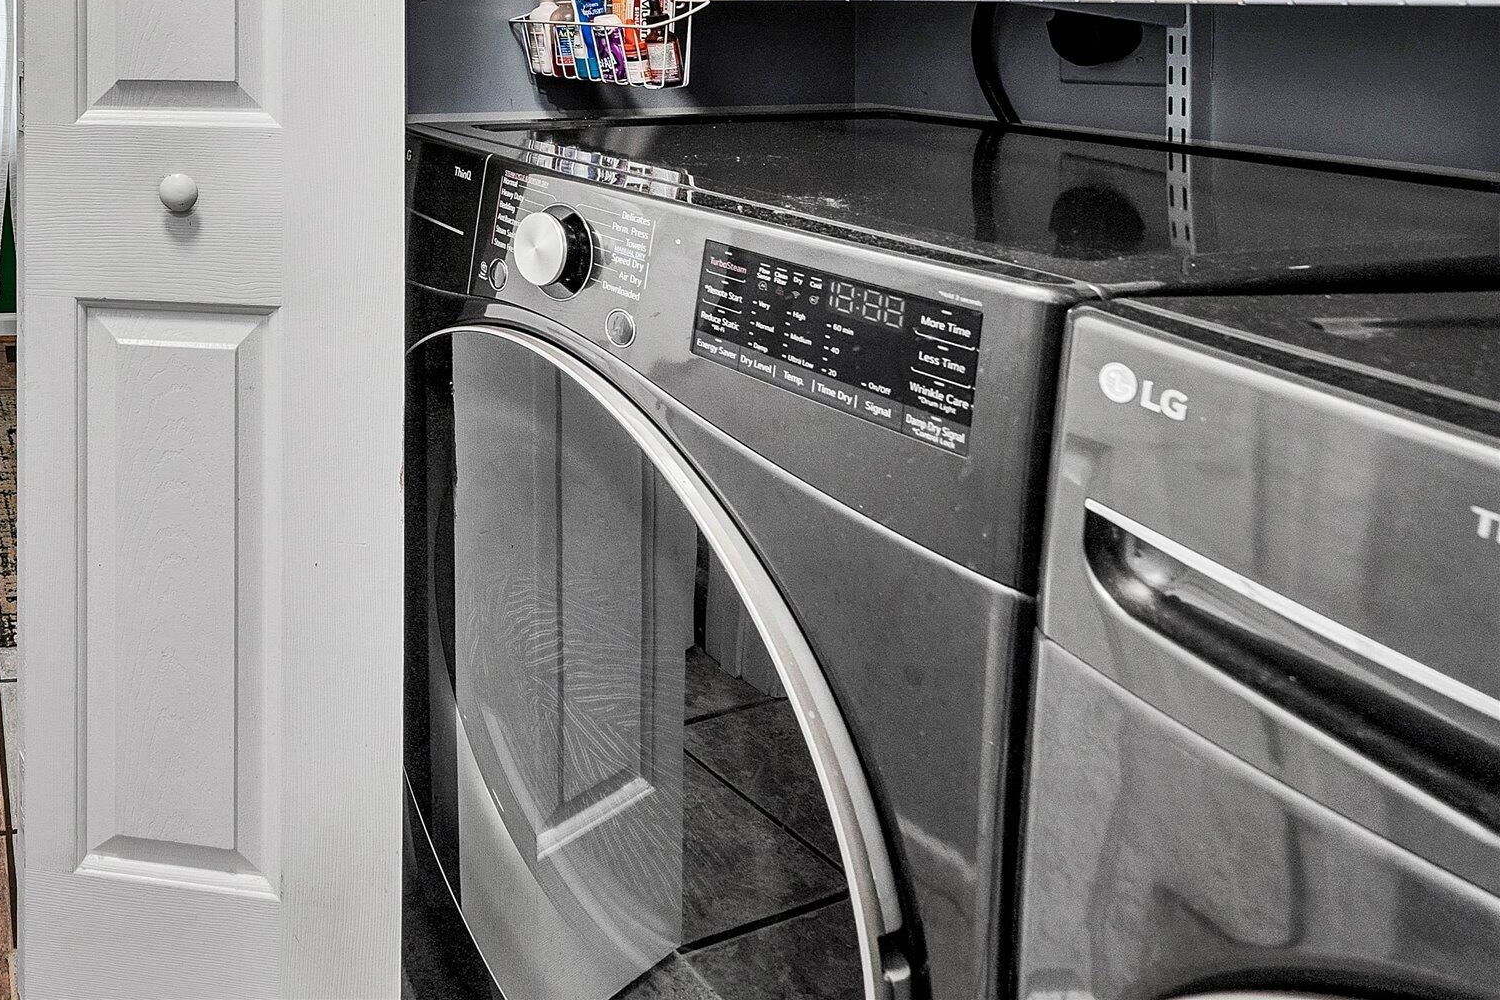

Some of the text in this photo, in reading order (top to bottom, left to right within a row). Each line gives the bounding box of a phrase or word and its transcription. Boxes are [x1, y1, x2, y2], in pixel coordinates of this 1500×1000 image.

[454, 166, 472, 181] ThinQ
[621, 211, 651, 226] Delicates
[630, 227, 649, 240] Press
[625, 238, 647, 253] Towels
[611, 253, 645, 272] Speed Dry
[710, 256, 747, 275] TurboSteam
[618, 271, 643, 287] Air Dry
[793, 276, 803, 286] Dry
[809, 281, 823, 290] Cool
[602, 280, 641, 301] Downloaded
[728, 291, 743, 304] Start
[758, 300, 771, 311] Very
[700, 310, 740, 331] Reduce Static
[792, 311, 806, 322] High
[755, 321, 775, 333] Normal
[832, 323, 854, 336] 60 min
[920, 315, 972, 338] More Time
[790, 333, 813, 346] Medium
[696, 338, 738, 360] Energy Saver
[752, 342, 769, 353] Damp
[830, 346, 841, 355] 40
[740, 354, 772, 374] Dry Level
[802, 359, 815, 370] Low
[918, 350, 967, 374] Less Time
[783, 369, 805, 387] Temp.
[827, 368, 838, 378] 20
[817, 382, 853, 404] Time Dry
[868, 381, 892, 396] On/Off
[909, 381, 970, 410] Wrinkle Care
[1140, 380, 1189, 421] LG
[864, 400, 892, 419] Signal
[905, 413, 966, 444] Damp Dry Signal
